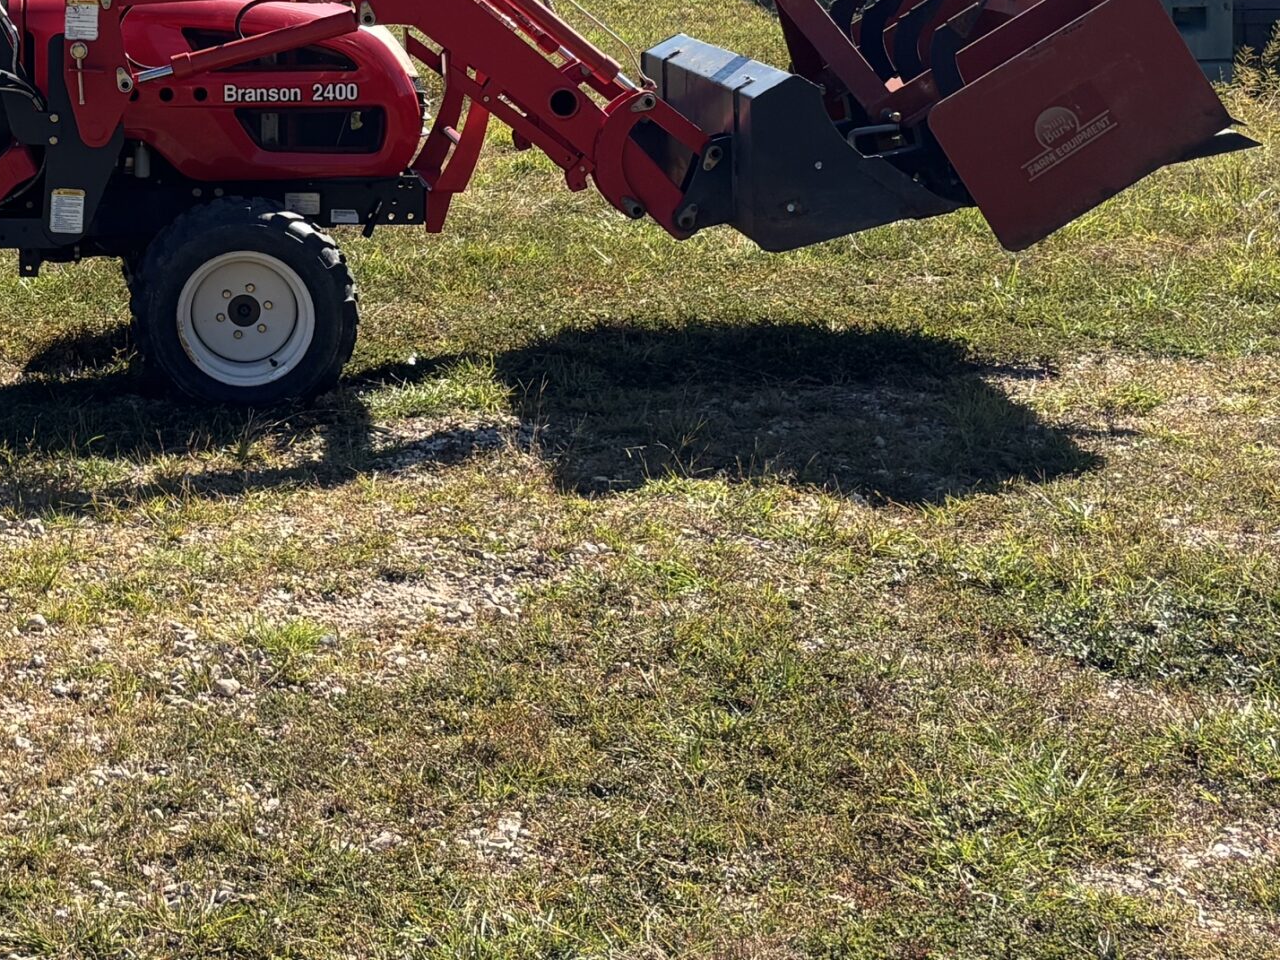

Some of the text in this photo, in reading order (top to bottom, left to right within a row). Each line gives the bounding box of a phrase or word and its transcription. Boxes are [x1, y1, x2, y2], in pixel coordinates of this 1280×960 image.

[223, 83, 358, 102] Branson 2400
[1041, 119, 1075, 144] Burst
[1026, 115, 1111, 177] FARM EQUIPMENT
